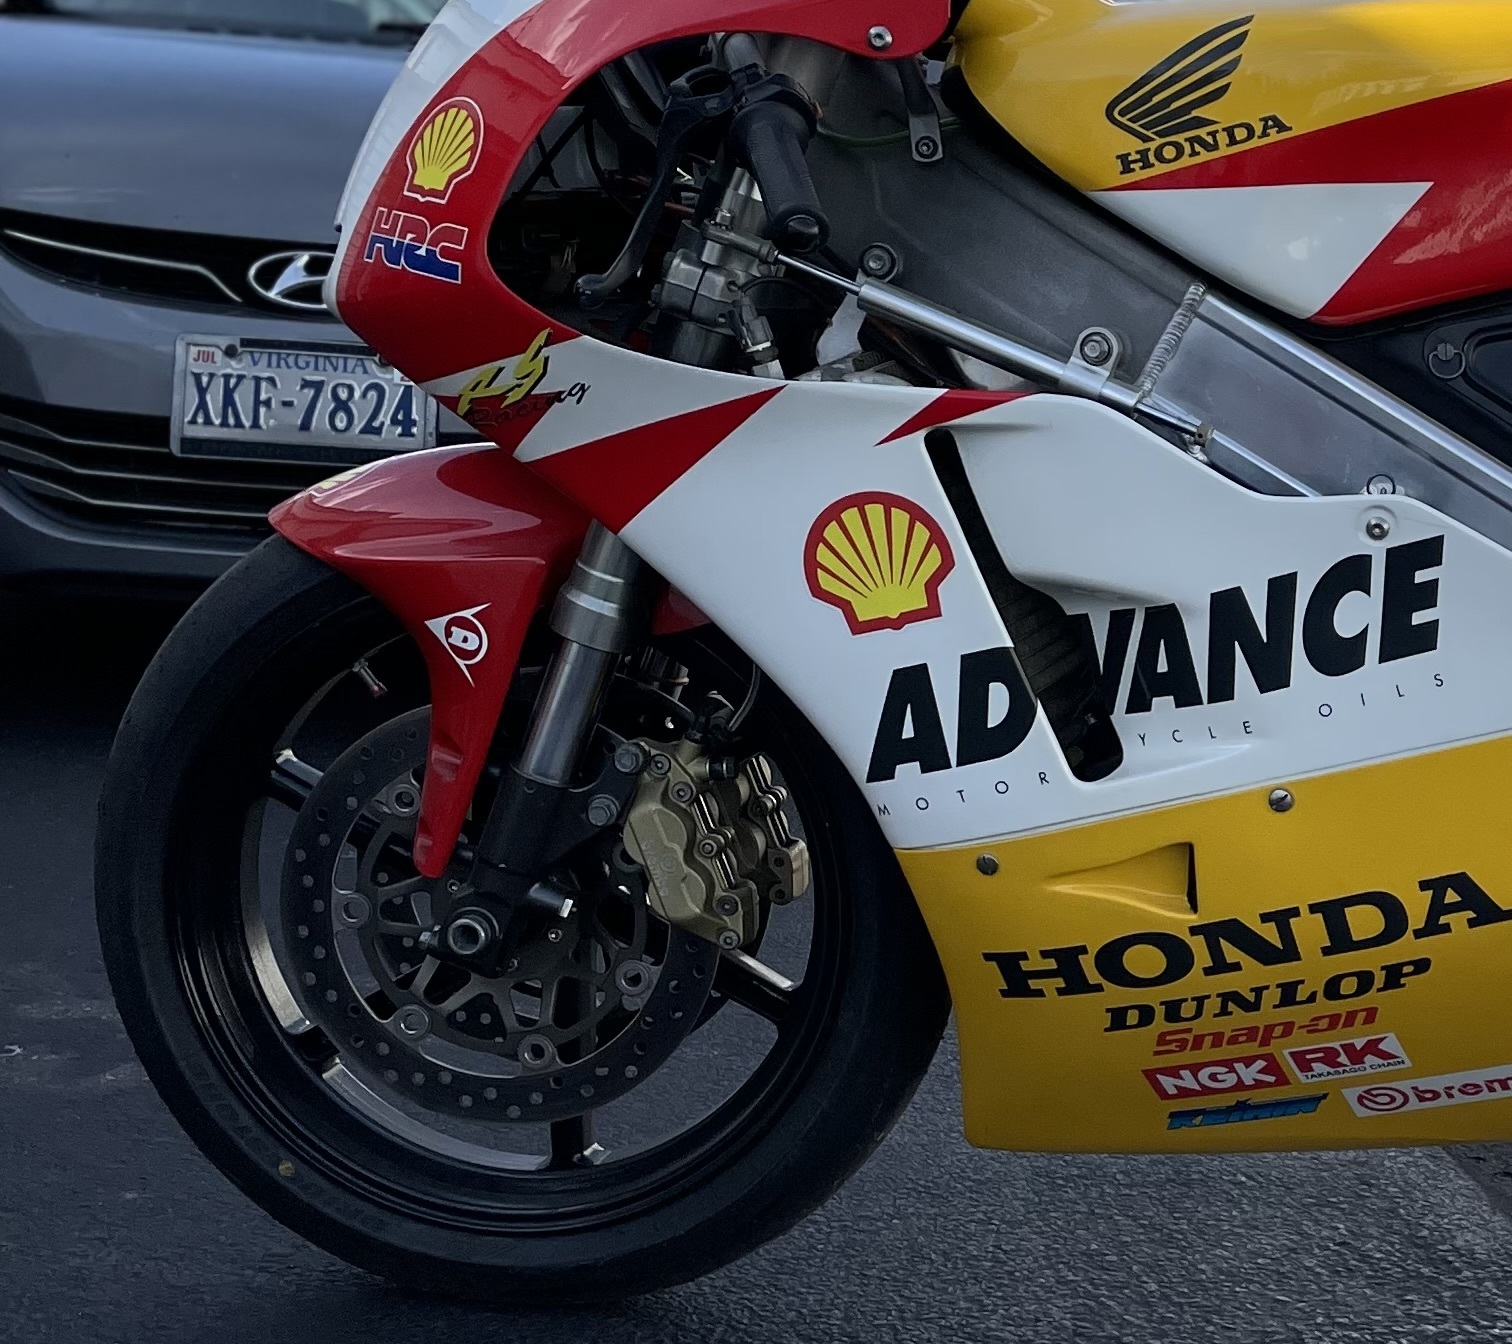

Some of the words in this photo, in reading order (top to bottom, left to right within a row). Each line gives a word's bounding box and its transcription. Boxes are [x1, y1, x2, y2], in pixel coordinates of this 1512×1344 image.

[1115, 114, 1293, 175] HONDA
[363, 207, 469, 284] HRC
[192, 349, 218, 365] JUL
[249, 351, 370, 375] VIRGINIA
[186, 370, 418, 438] XKF-7824
[865, 534, 1445, 784] ADVANCE
[877, 720, 1253, 817] MOTORYCLE
[1318, 672, 1445, 717] OILS
[1103, 957, 1432, 1033] DUNLOP
[1153, 1005, 1380, 1057] Snap-on
[1288, 1036, 1402, 1074] RK
[1156, 1059, 1277, 1095] NGK
[1369, 1059, 1406, 1070] CHAIN
